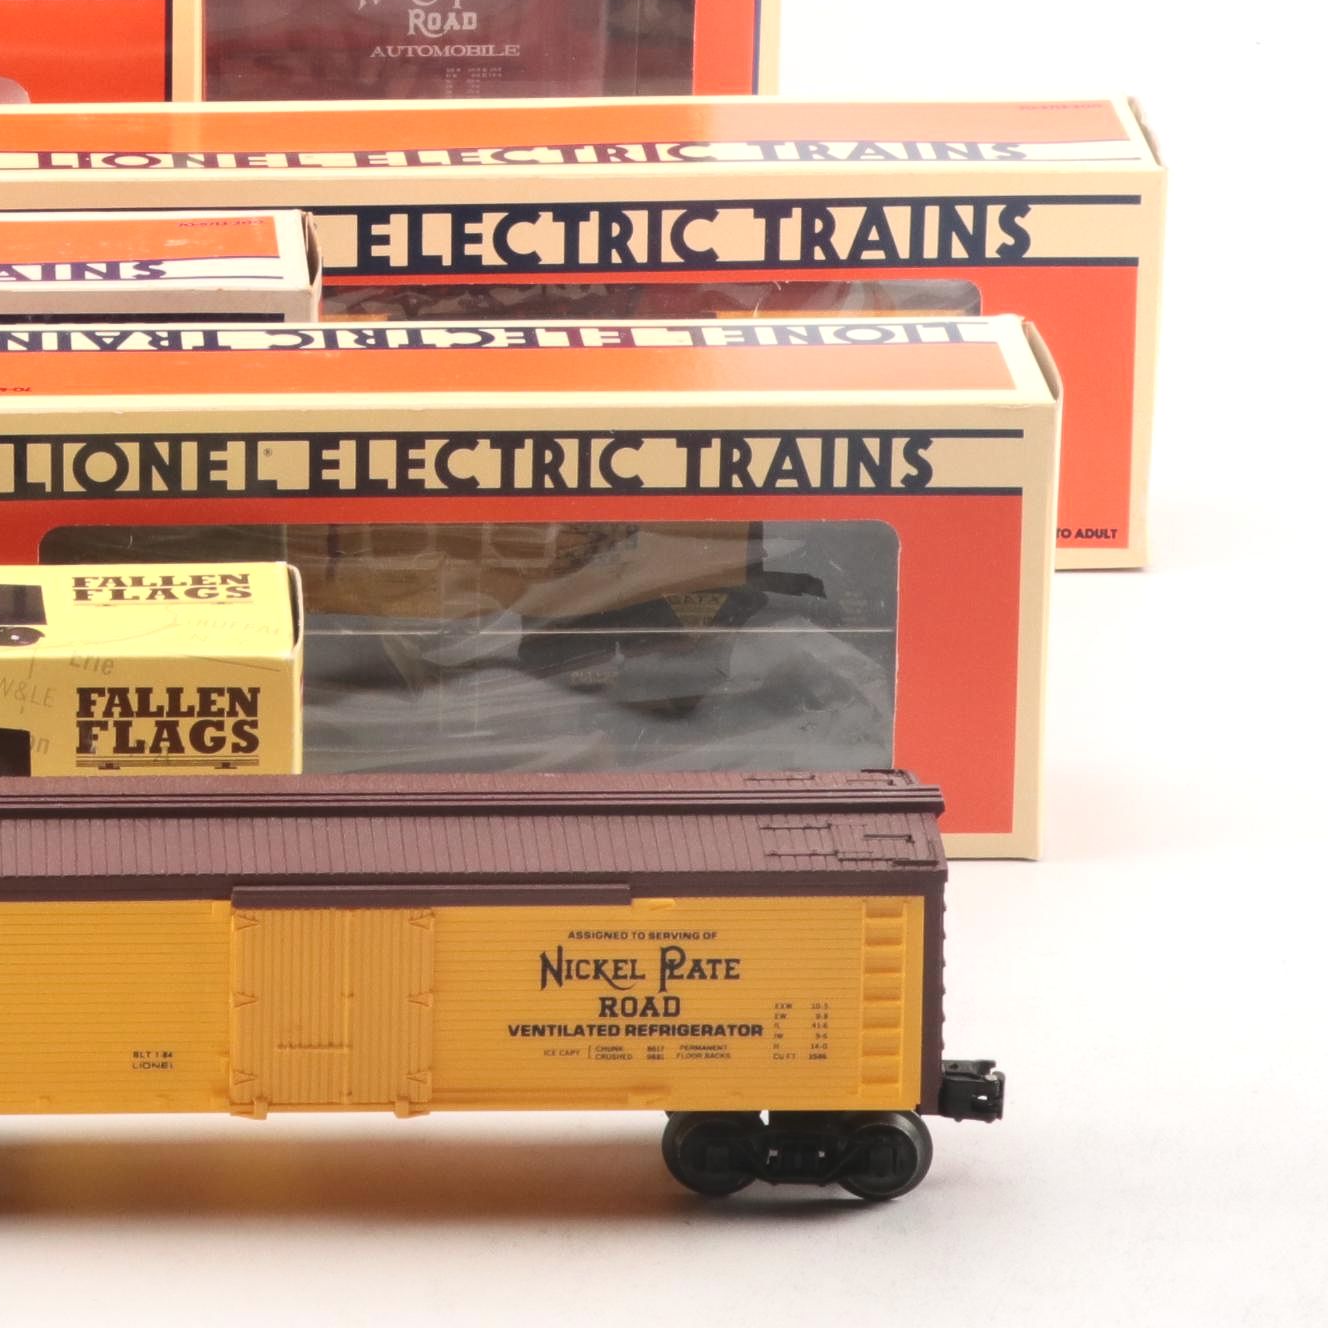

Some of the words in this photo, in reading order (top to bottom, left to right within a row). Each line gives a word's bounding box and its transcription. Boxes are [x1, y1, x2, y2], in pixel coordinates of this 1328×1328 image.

[407, 9, 478, 38] ROAD
[370, 44, 521, 58] AUTOMOBILE
[38, 152, 308, 168] LIONEL
[354, 145, 718, 166] ELECTRIC
[745, 141, 1029, 161] TRAINS
[358, 205, 719, 272] ELECTRIC
[754, 202, 1032, 267] TRAINS
[266, 327, 625, 350] ELECTRIC
[667, 323, 964, 347] LIONEL
[13, 437, 278, 495] LIONEL
[309, 433, 644, 493] ELECTRIC
[676, 432, 934, 492] TRAINS
[1075, 528, 1118, 539] ADULT
[72, 574, 251, 588] FALLEN
[73, 586, 252, 601] FLAGS
[76, 687, 260, 718] FALLEN
[76, 719, 260, 755] FLAGS
[568, 931, 628, 940] ASSIGNED
[632, 931, 646, 940] TO
[648, 931, 699, 940] SERVING
[702, 931, 717, 940] OF
[540, 945, 646, 991] NICKEL
[657, 945, 740, 993] PLATE
[598, 996, 681, 1018] ROAD
[508, 1024, 621, 1037] VENTILATED
[625, 1024, 763, 1037] REFRIGERATOR
